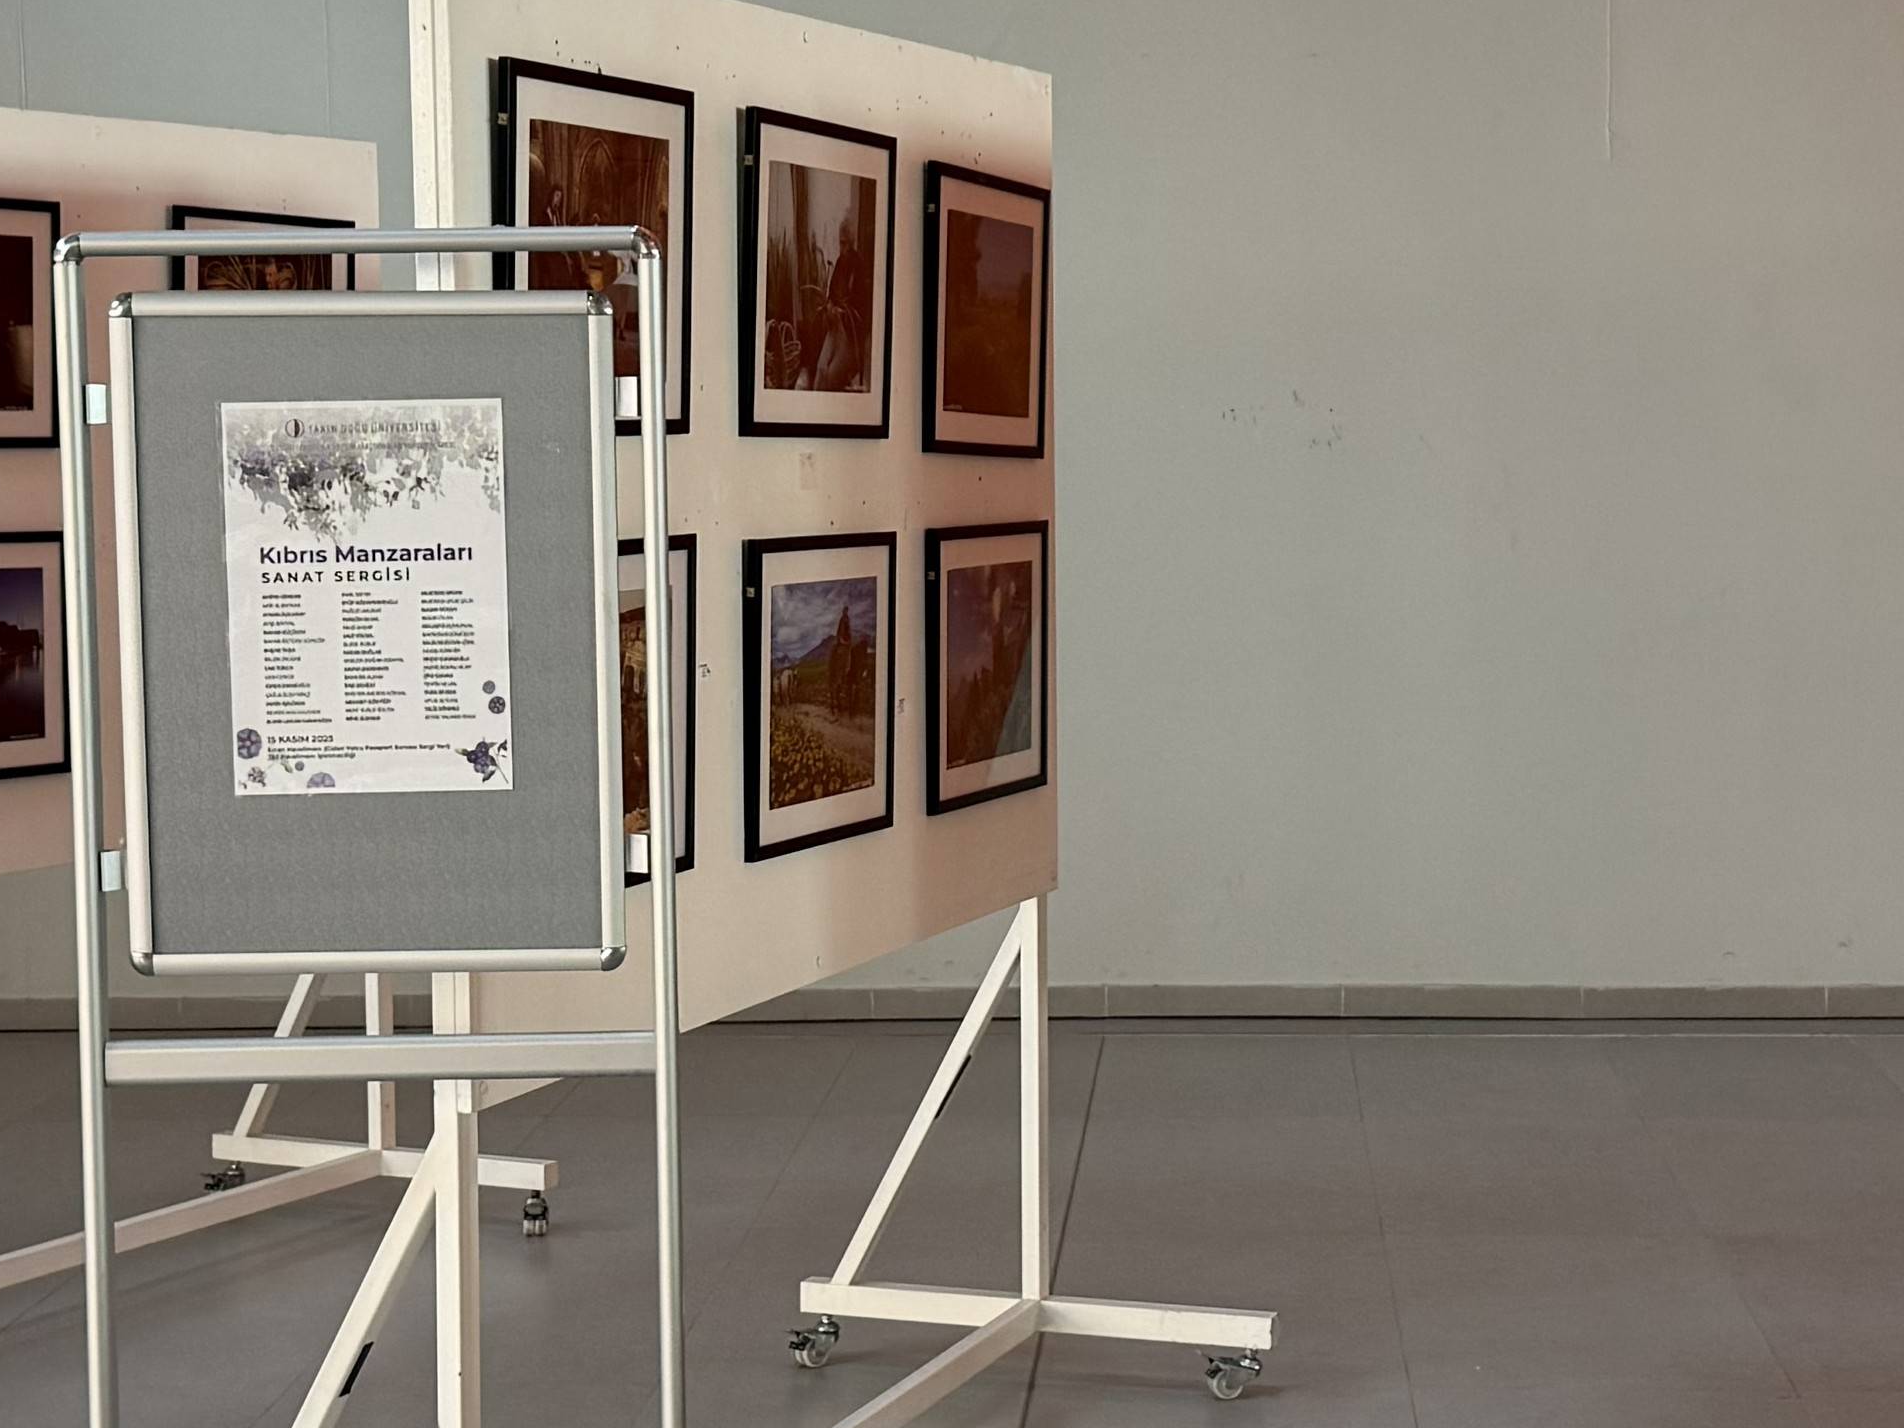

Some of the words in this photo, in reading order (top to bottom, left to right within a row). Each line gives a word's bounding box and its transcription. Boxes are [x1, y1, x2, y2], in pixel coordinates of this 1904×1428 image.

[260, 545, 327, 564] Kıbrıs
[335, 543, 473, 563] Manzaraları
[261, 571, 324, 583] SANAT
[334, 567, 410, 582] SERGİSİ
[278, 735, 309, 744] KASIM
